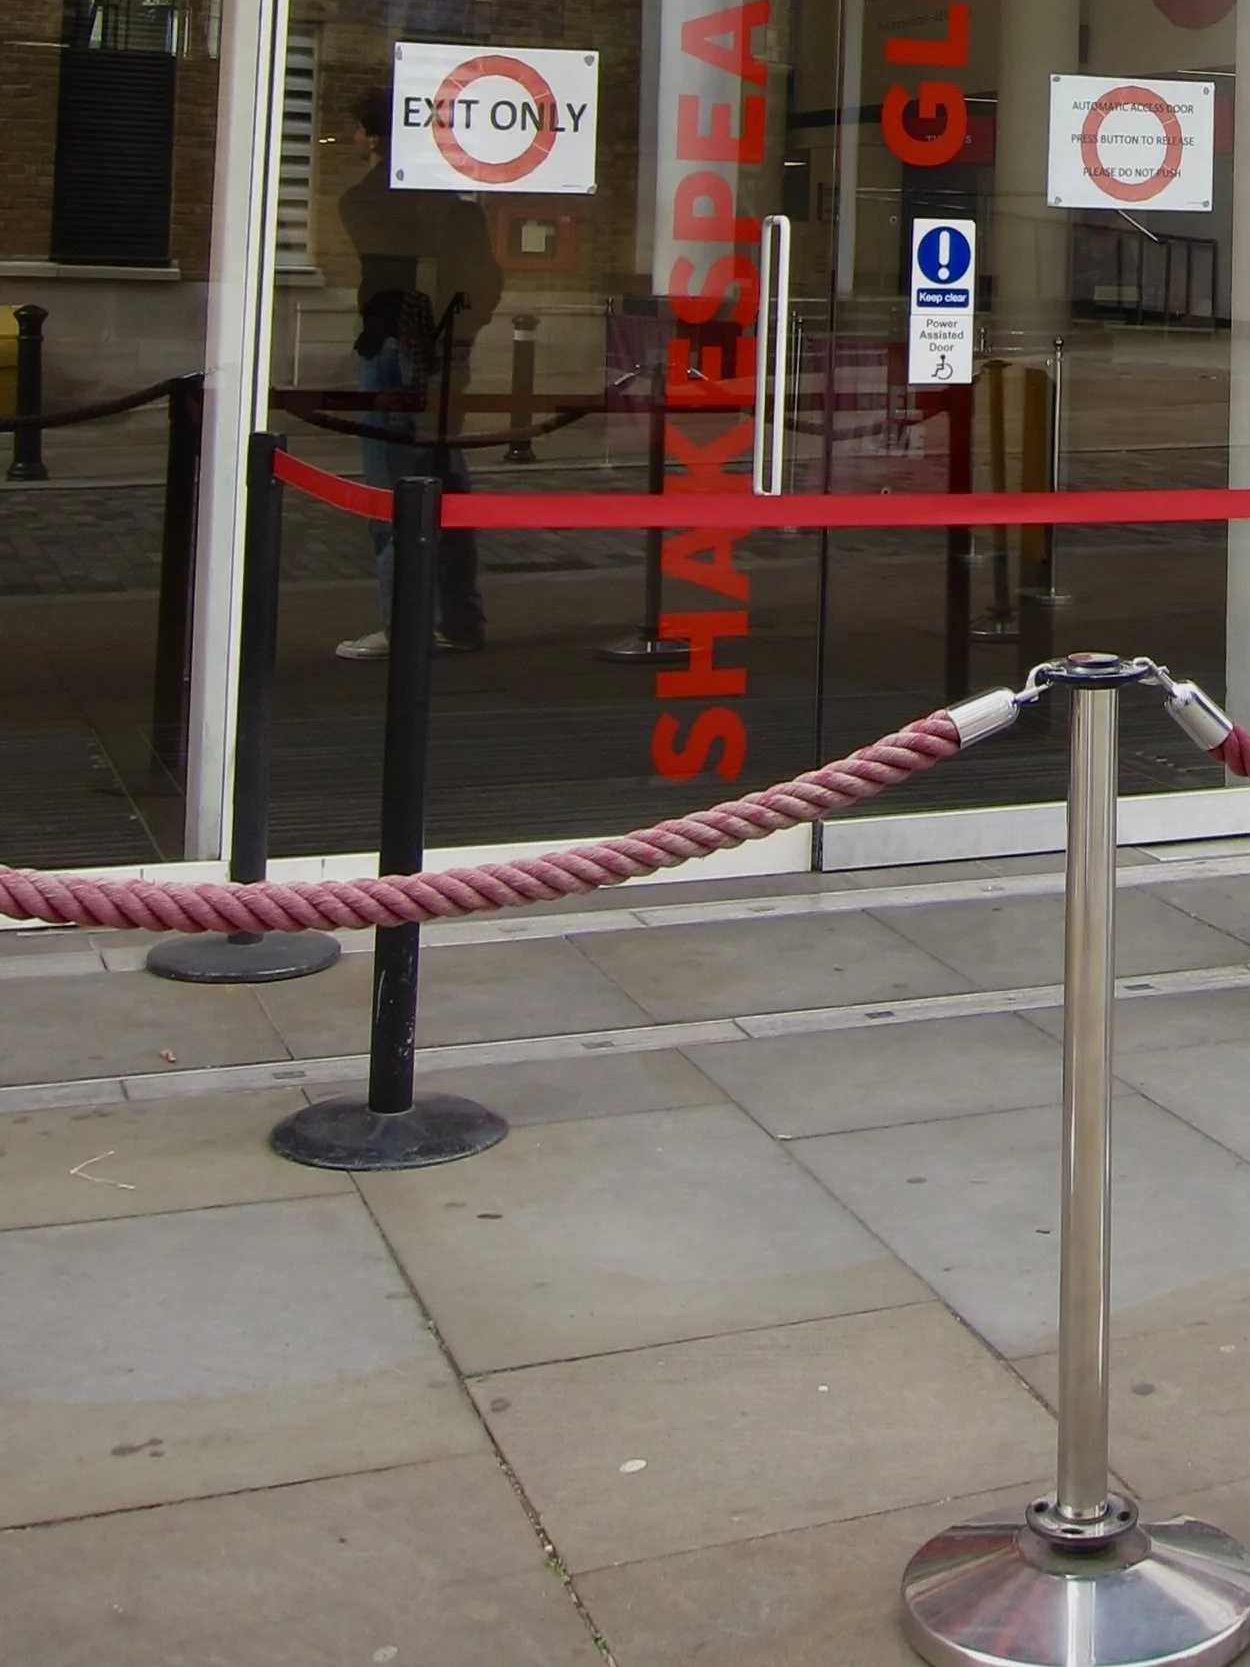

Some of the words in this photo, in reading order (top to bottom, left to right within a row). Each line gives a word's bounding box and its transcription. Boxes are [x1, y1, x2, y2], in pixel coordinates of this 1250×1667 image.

[1072, 101, 1129, 112] AUTOMATIC
[1131, 103, 1164, 114] ACCESS
[1166, 104, 1194, 114] DOOR
[403, 96, 480, 129] EXIT
[490, 100, 588, 133] ONLY
[1071, 133, 1099, 144] PRESS
[1100, 135, 1139, 145] BUTTON
[1142, 135, 1154, 146] TO
[1156, 136, 1195, 146] RELEASE
[1083, 166, 1117, 177] PLEASE
[1118, 167, 1133, 177] DO
[1135, 167, 1153, 178] NOT
[1156, 168, 1181, 178] PUSH
[919, 292, 943, 304] Keep
[944, 292, 967, 303] clear
[926, 318, 958, 328] Power
[919, 330, 964, 340] Assisted
[929, 343, 954, 352] Door
